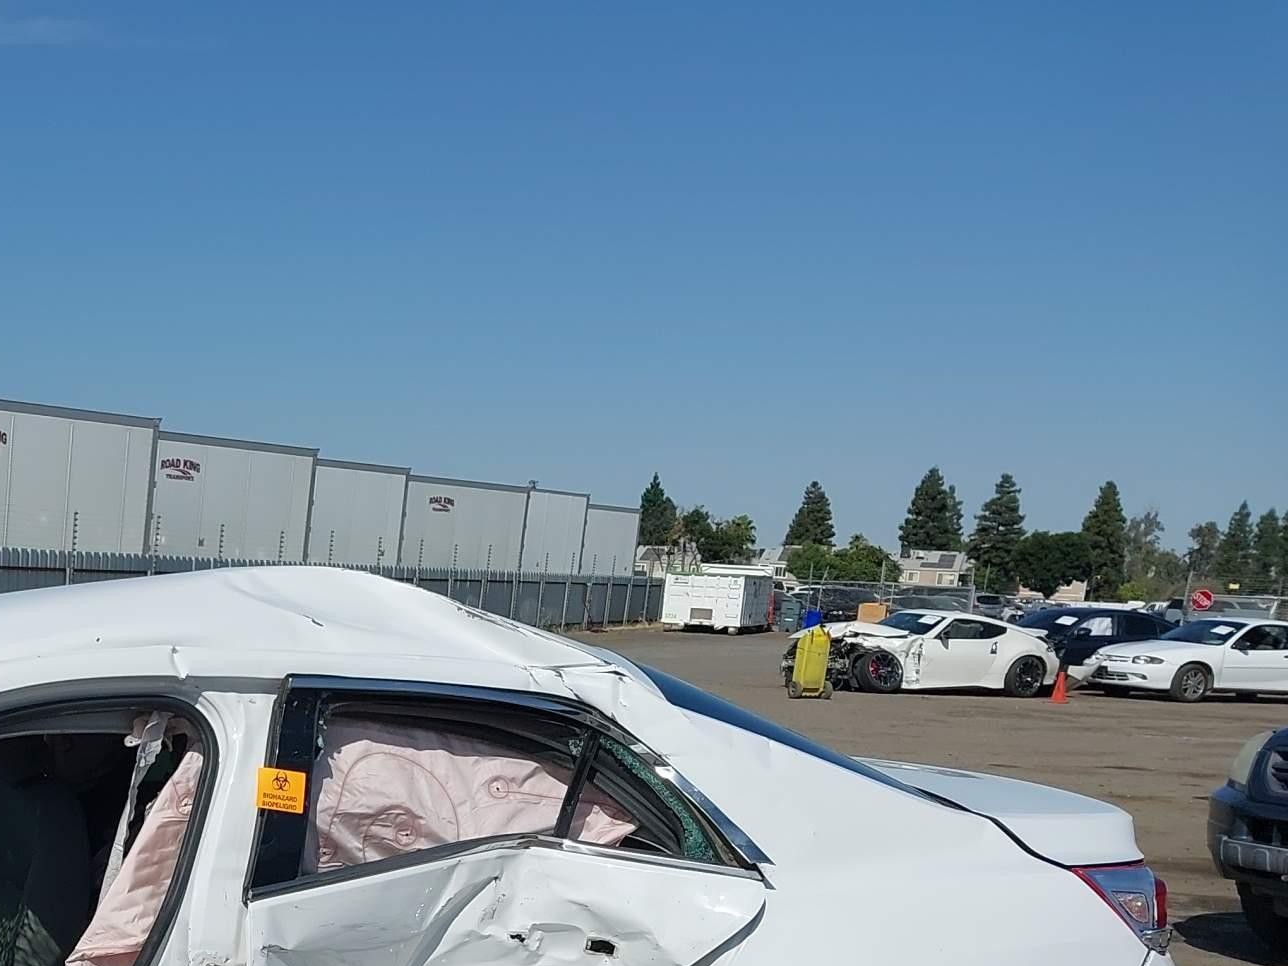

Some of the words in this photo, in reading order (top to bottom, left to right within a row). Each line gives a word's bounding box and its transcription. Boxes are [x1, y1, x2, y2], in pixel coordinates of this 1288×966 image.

[160, 458, 181, 470] ROAD
[182, 459, 201, 473] KING
[1193, 592, 1211, 606] STOP
[262, 792, 298, 803] BIOHAZARD
